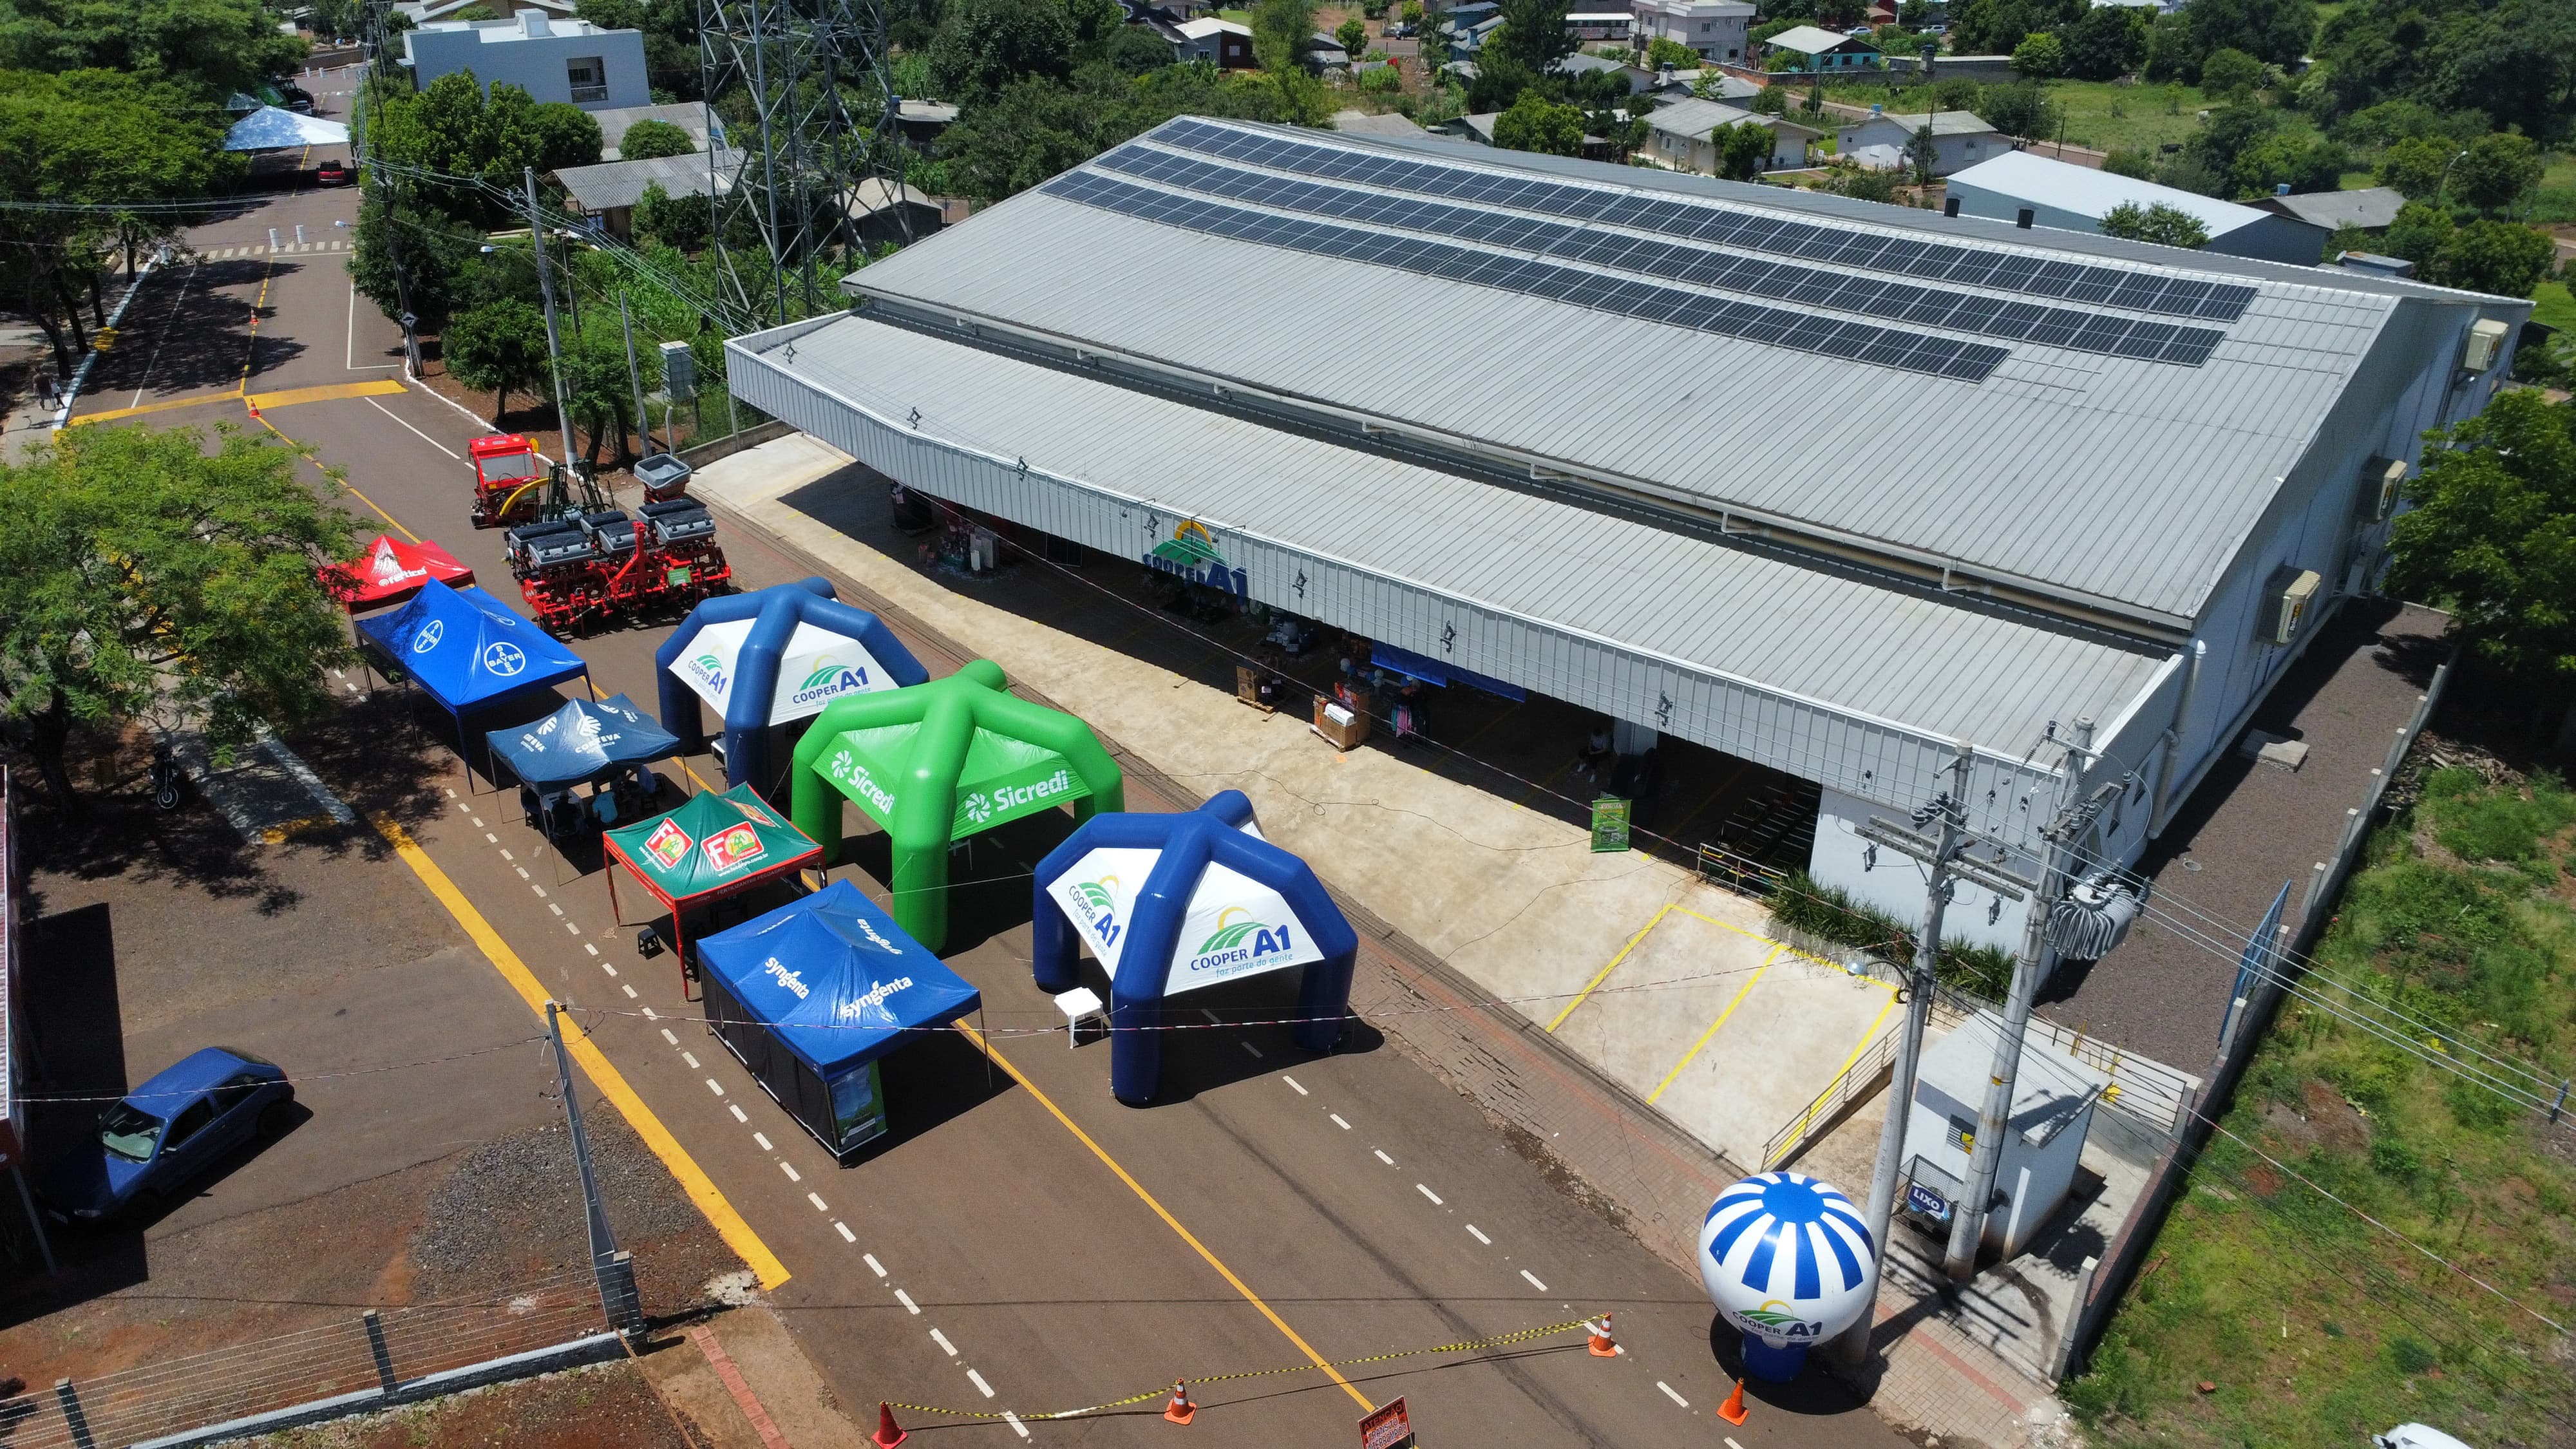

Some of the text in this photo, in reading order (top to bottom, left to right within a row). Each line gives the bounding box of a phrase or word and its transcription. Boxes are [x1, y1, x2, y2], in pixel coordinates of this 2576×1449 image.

[1206, 560, 1247, 606] A1
[422, 630, 437, 645] BAYER
[488, 652, 522, 667] BAYER
[495, 645, 515, 673] BAYER
[688, 660, 710, 683] COOPER
[708, 671, 727, 694] A1
[793, 666, 869, 704] COOPER A1
[848, 765, 895, 815] Sicredi
[994, 770, 1069, 811] Sicredi
[707, 837, 724, 866] F
[1069, 885, 1121, 948] COOPER A1
[1191, 924, 1291, 971] COOPER A1
[764, 957, 810, 999] syngenta
[1216, 953, 1293, 979] faz parte da gente
[840, 976, 913, 1018] syngenta
[1913, 1189, 1940, 1211] LIXO
[1732, 1311, 1823, 1336] COOPER A1
